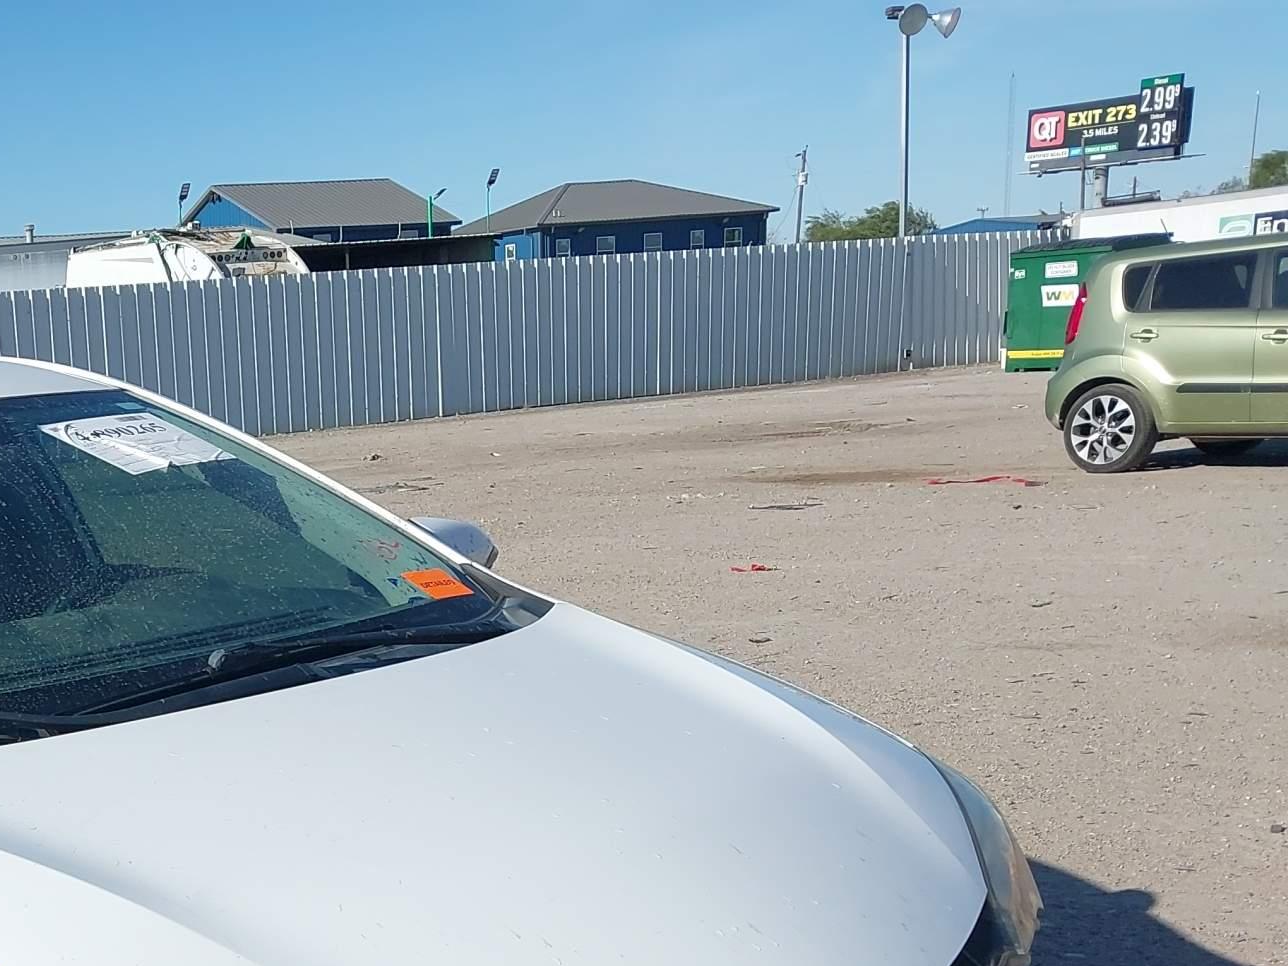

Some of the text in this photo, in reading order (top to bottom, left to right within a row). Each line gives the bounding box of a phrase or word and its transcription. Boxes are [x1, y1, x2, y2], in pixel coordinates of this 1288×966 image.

[1067, 109, 1103, 127] EXIT
[1105, 104, 1136, 122] 273
[1034, 116, 1060, 142] QT
[1095, 126, 1118, 136] MILES
